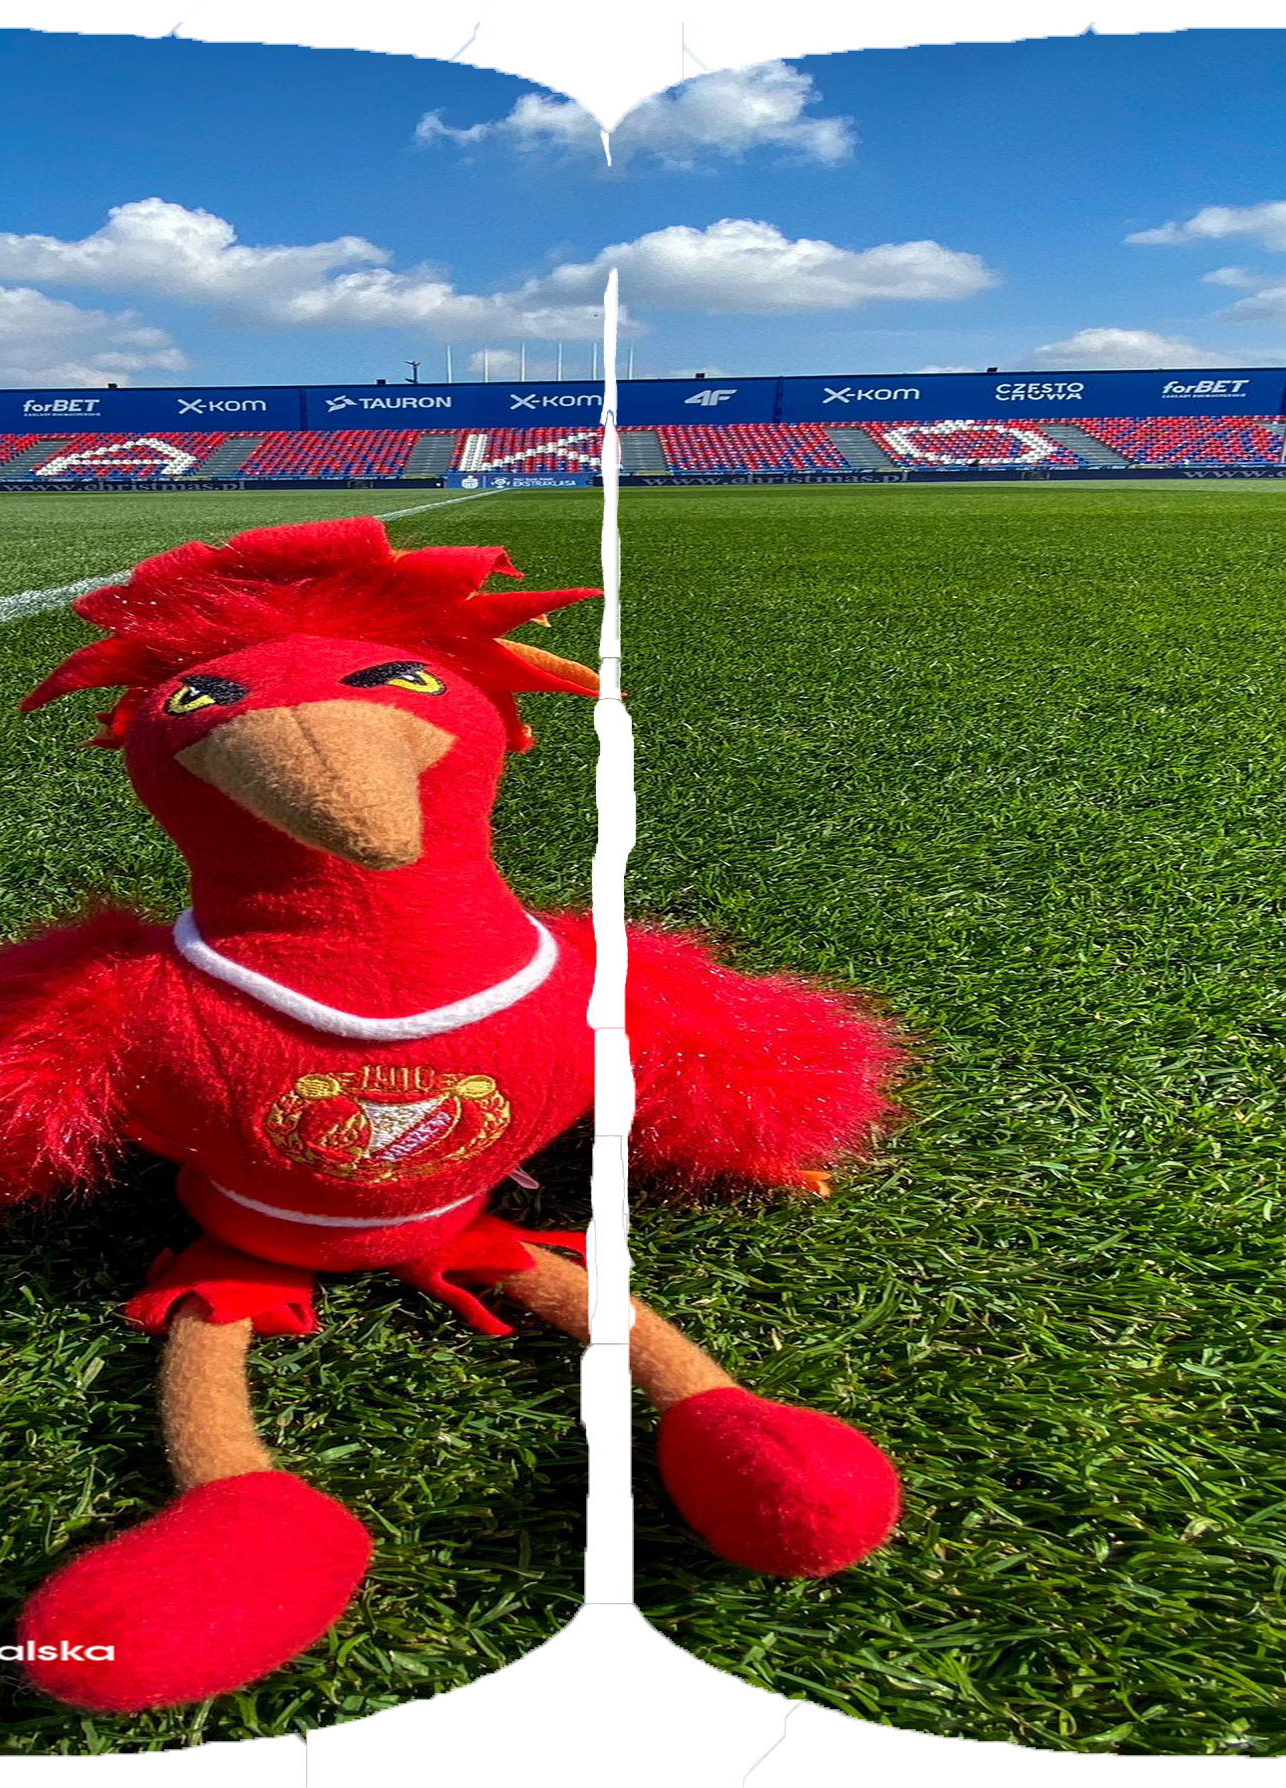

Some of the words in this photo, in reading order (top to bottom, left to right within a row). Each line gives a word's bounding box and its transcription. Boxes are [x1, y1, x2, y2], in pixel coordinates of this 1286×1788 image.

[1162, 380, 1251, 394] forBET
[358, 397, 453, 409] TAURON
[683, 389, 738, 406] 4F
[23, 399, 101, 412] forBET
[361, 1065, 435, 1091] 1910
